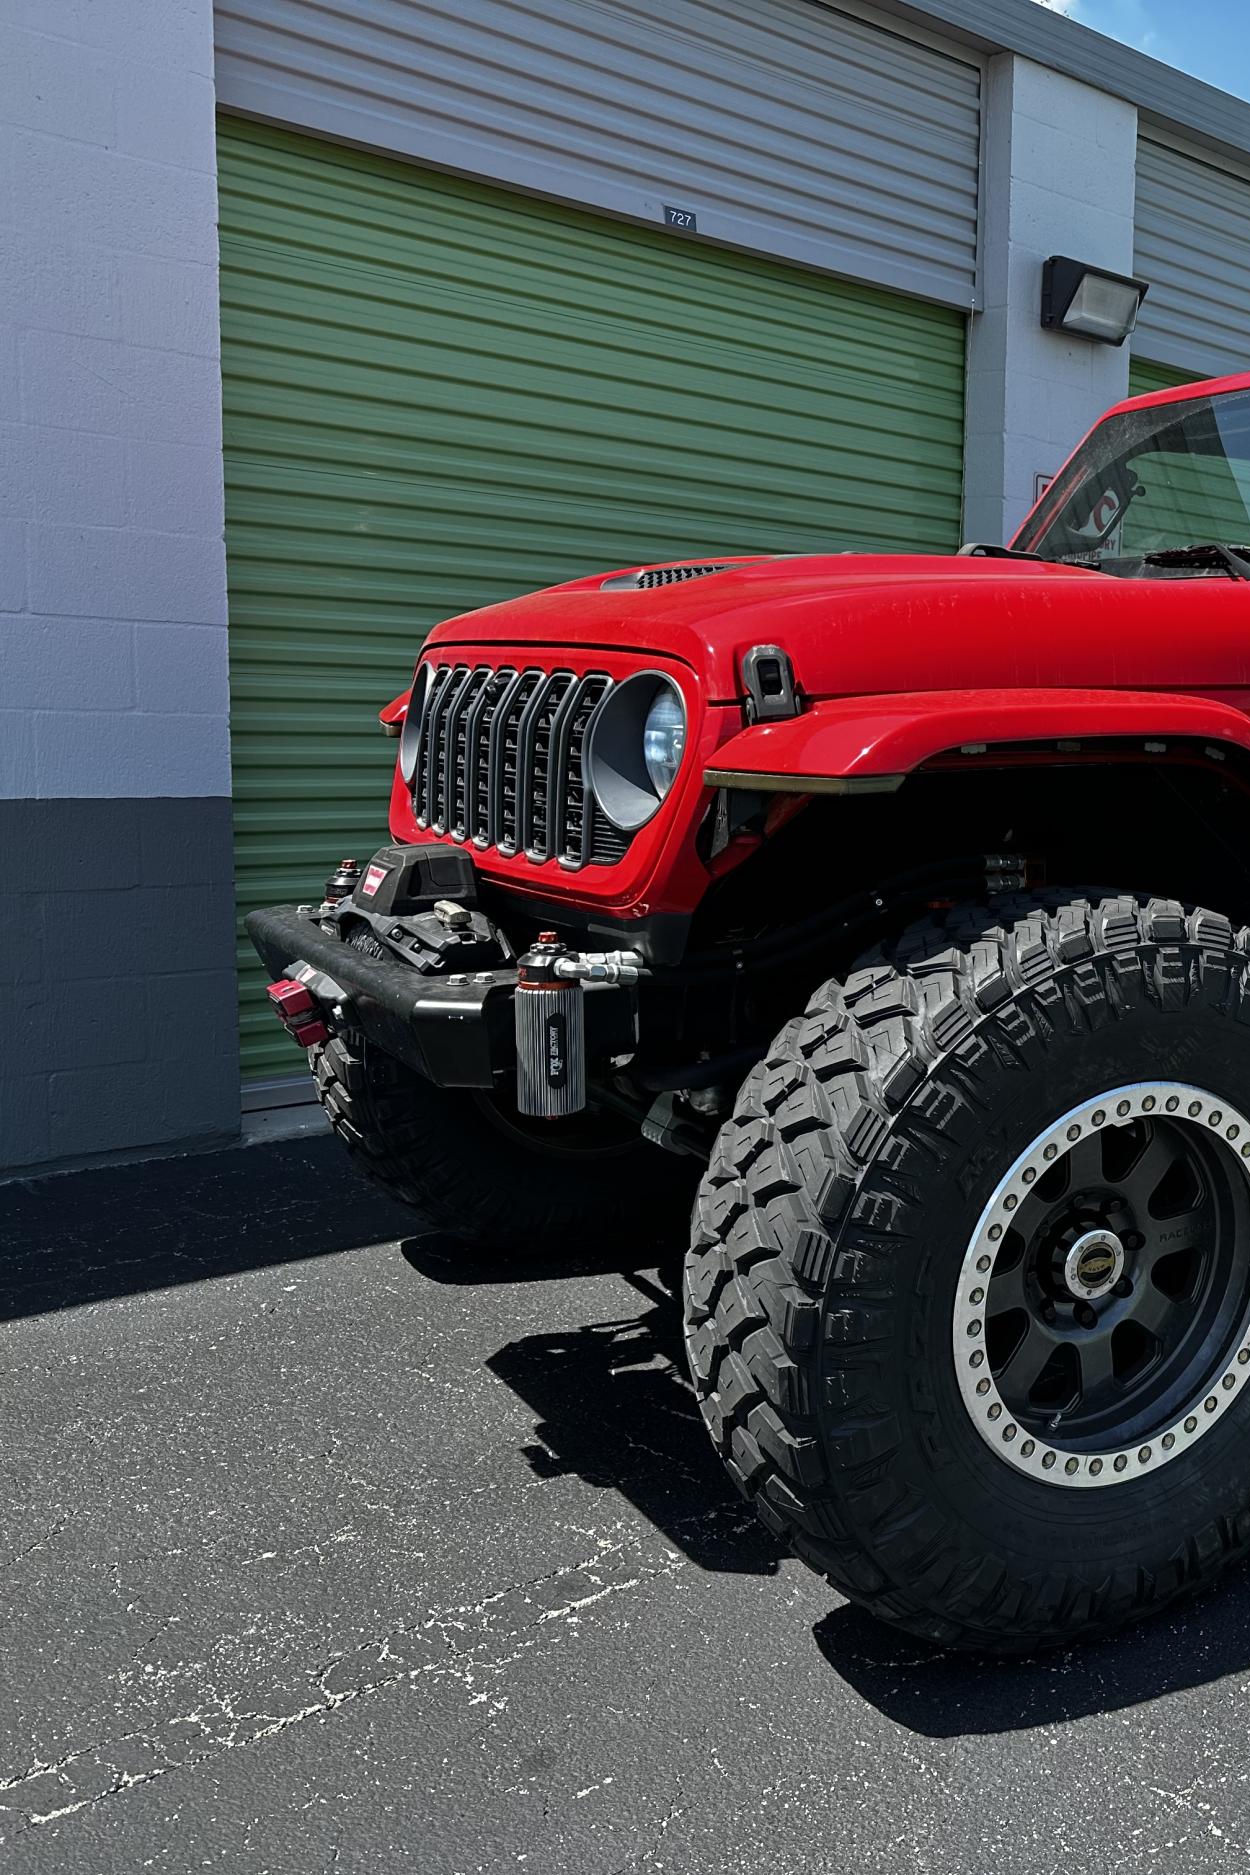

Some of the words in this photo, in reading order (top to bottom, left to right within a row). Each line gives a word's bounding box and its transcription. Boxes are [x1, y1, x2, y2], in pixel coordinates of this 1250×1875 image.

[669, 210, 691, 226] 727
[549, 1026, 559, 1056] FACTORY
[549, 1057, 563, 1076] FOX
